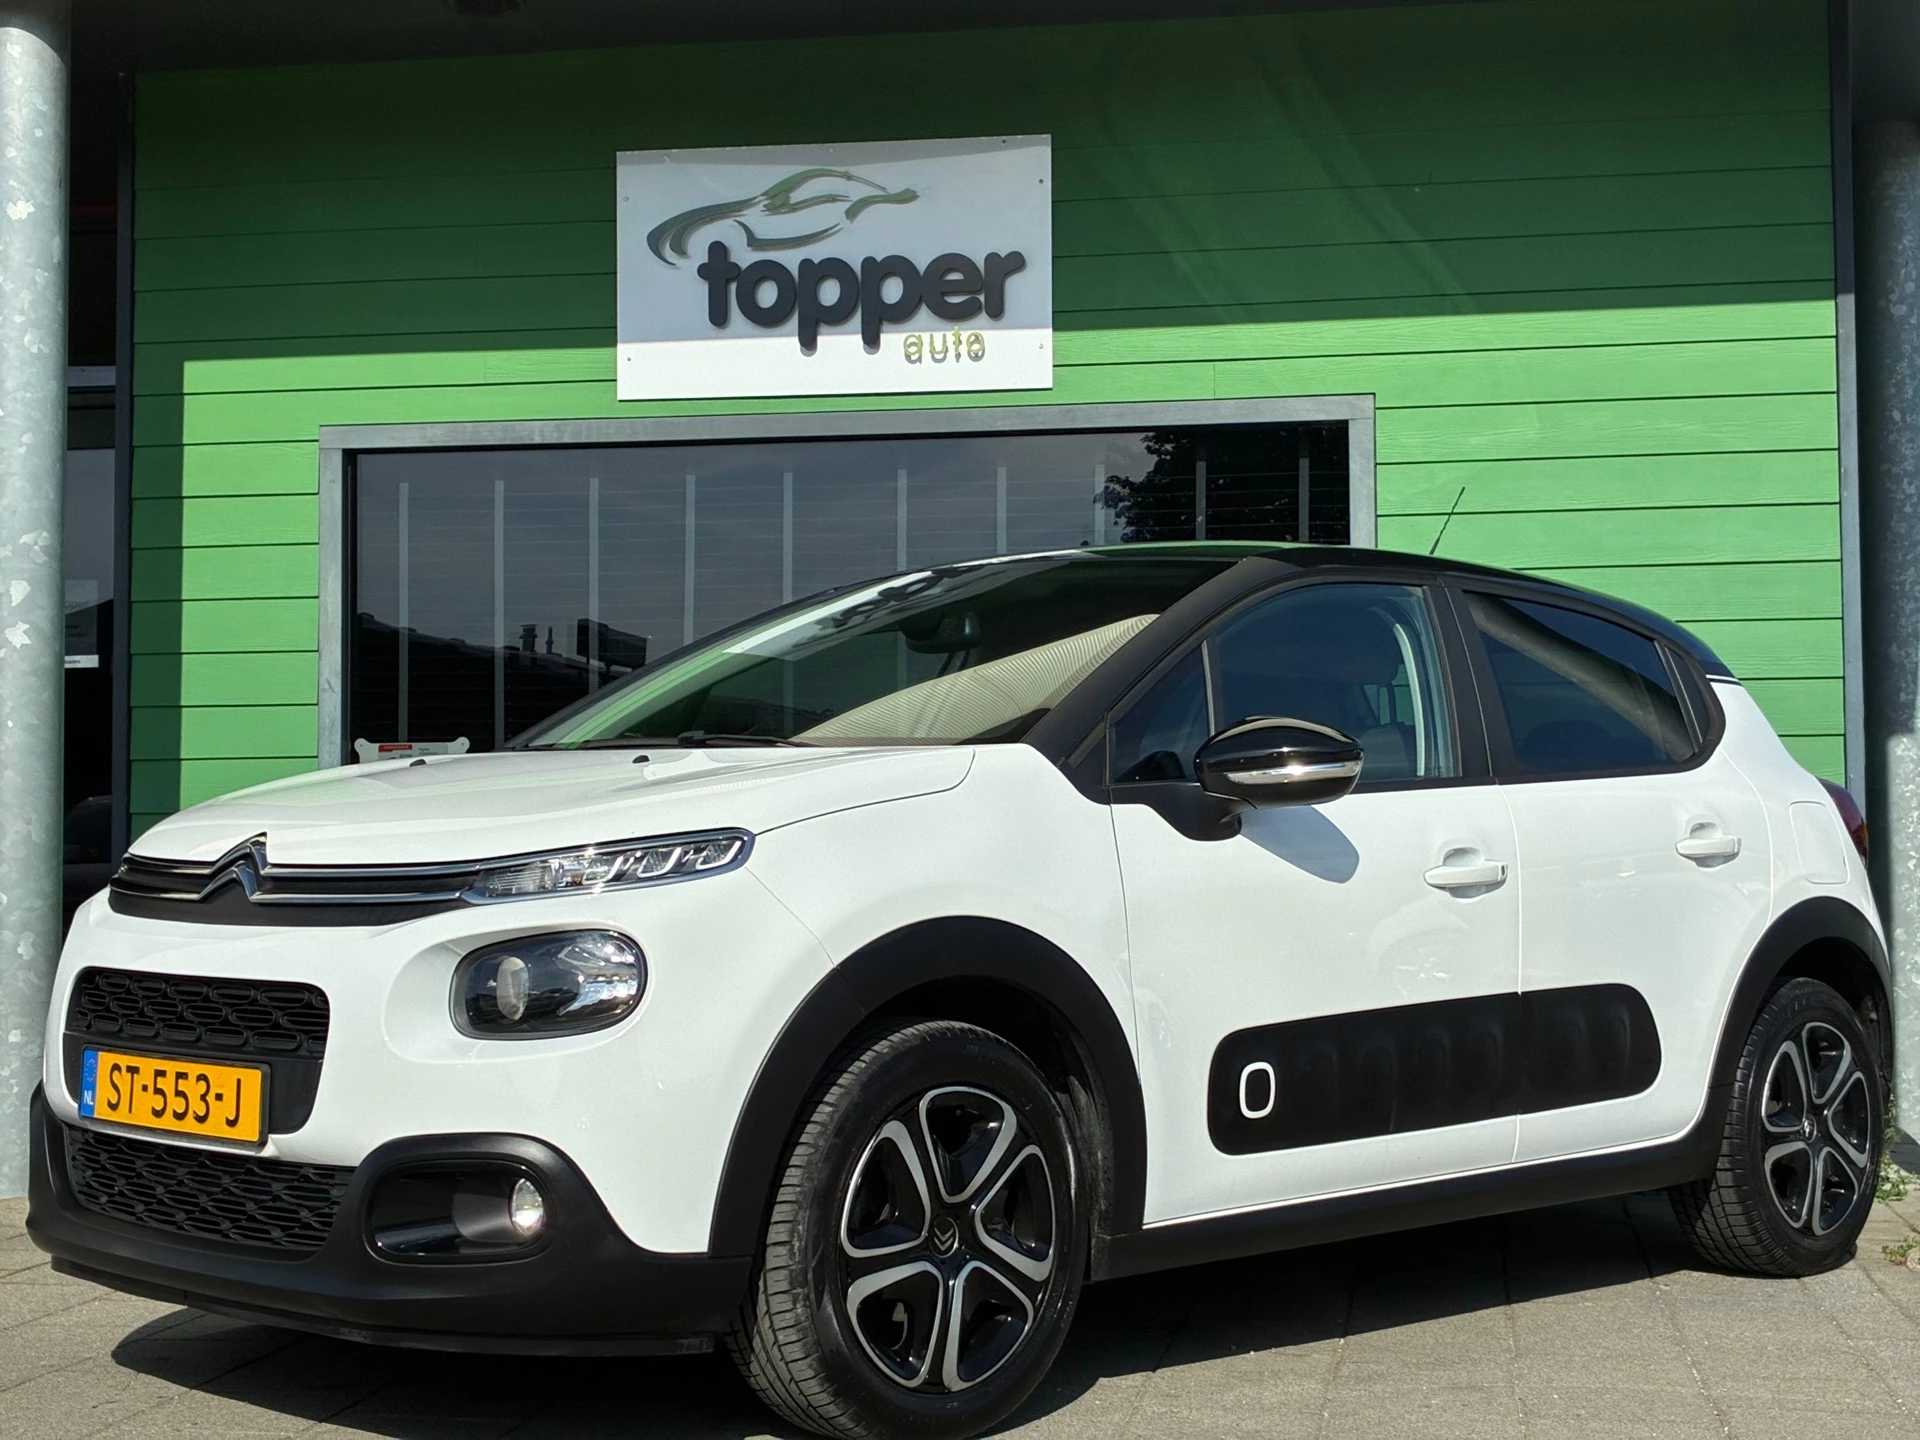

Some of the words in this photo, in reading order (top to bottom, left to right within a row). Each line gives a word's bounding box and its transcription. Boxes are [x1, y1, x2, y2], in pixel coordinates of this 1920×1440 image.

[697, 241, 1026, 351] topper
[903, 325, 985, 361] auto
[83, 1089, 95, 1106] NL
[106, 1062, 242, 1128] ST-553-J
